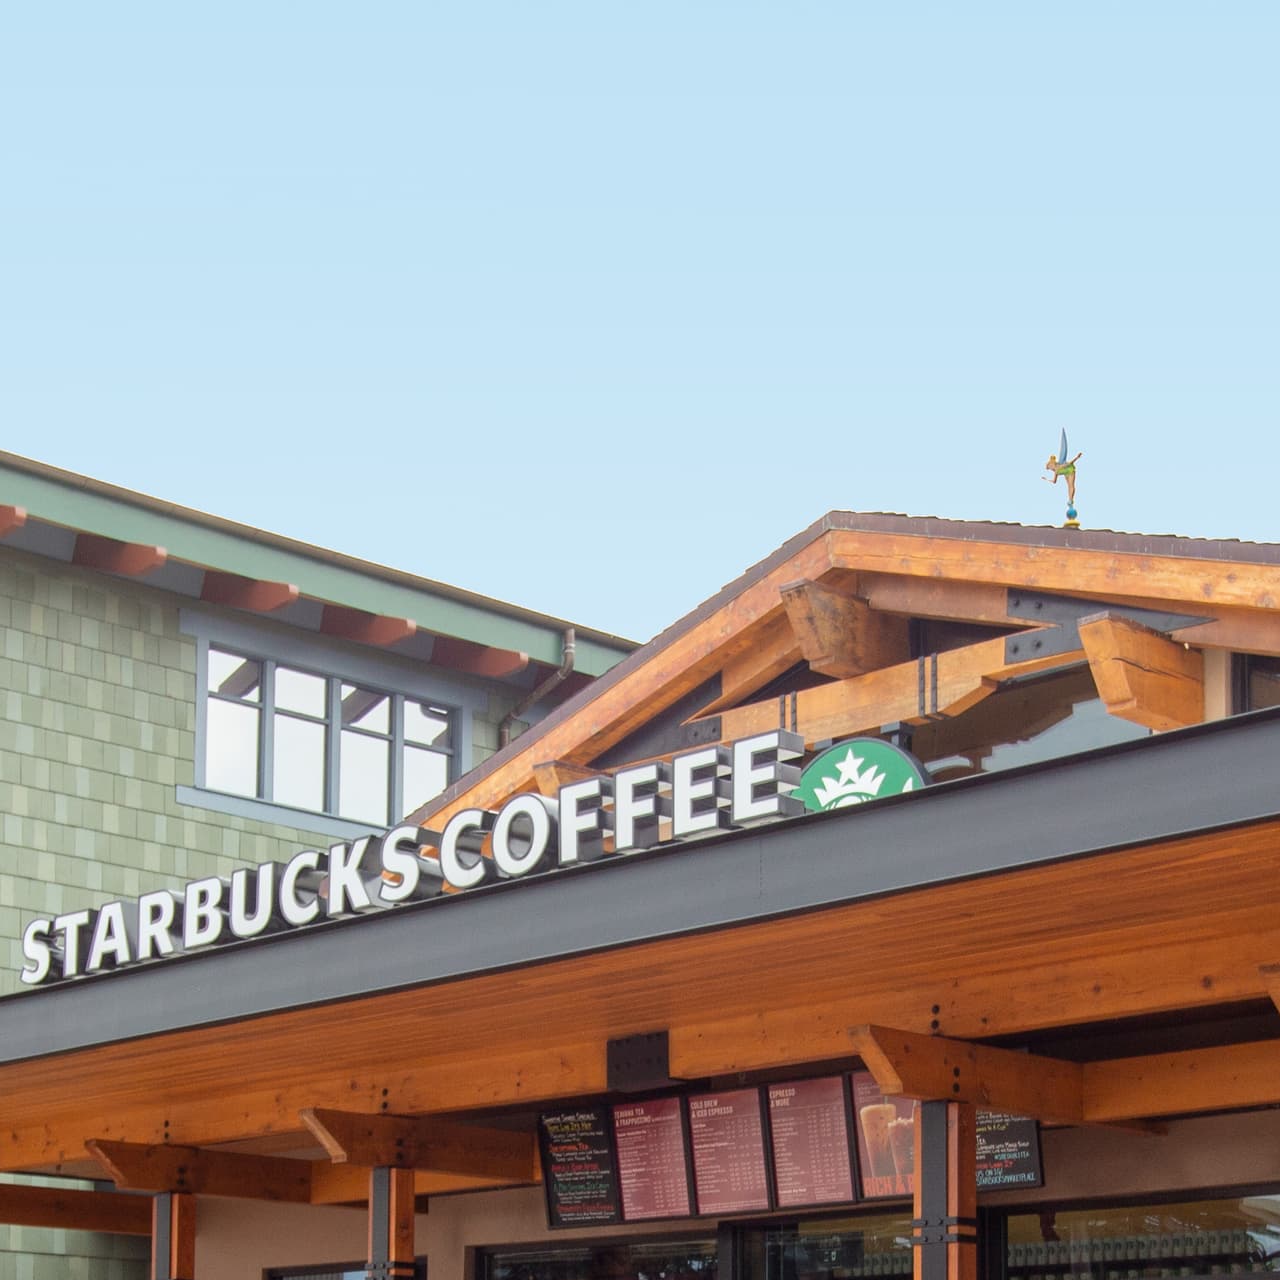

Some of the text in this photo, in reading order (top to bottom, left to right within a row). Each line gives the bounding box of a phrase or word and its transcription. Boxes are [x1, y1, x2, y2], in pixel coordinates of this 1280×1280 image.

[20, 729, 786, 986] STARBUCKS COFFEE
[769, 1088, 796, 1099] ESPRESSO
[690, 1099, 718, 1110] COLD BREW
[776, 1098, 790, 1107] MORE
[708, 1105, 734, 1116] ESPRESSO
[863, 1175, 893, 1198] RICH
